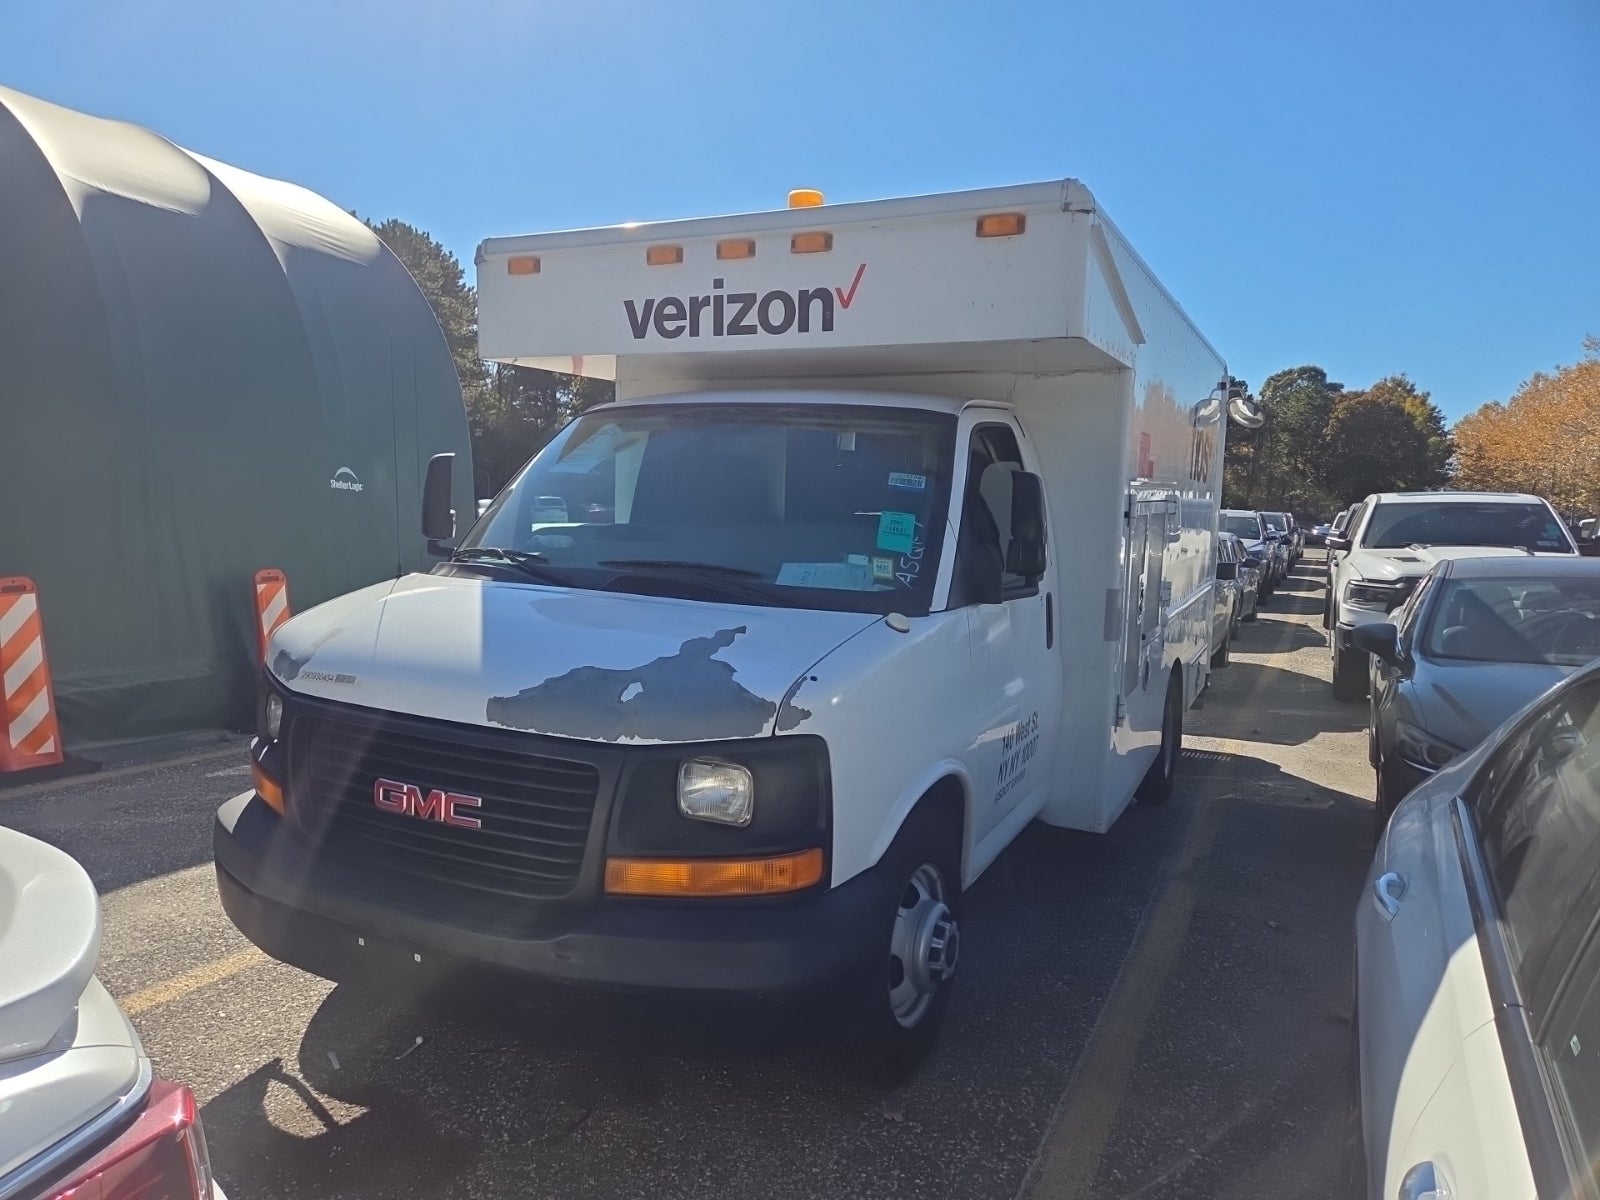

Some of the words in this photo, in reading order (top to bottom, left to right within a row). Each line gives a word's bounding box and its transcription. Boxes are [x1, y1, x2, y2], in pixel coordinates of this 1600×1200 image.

[624, 278, 834, 339] verizon
[1002, 727, 1015, 755] 140
[1015, 715, 1031, 746] West
[997, 755, 1010, 786] NY
[1009, 747, 1022, 776] NY
[374, 778, 482, 829] GMC
